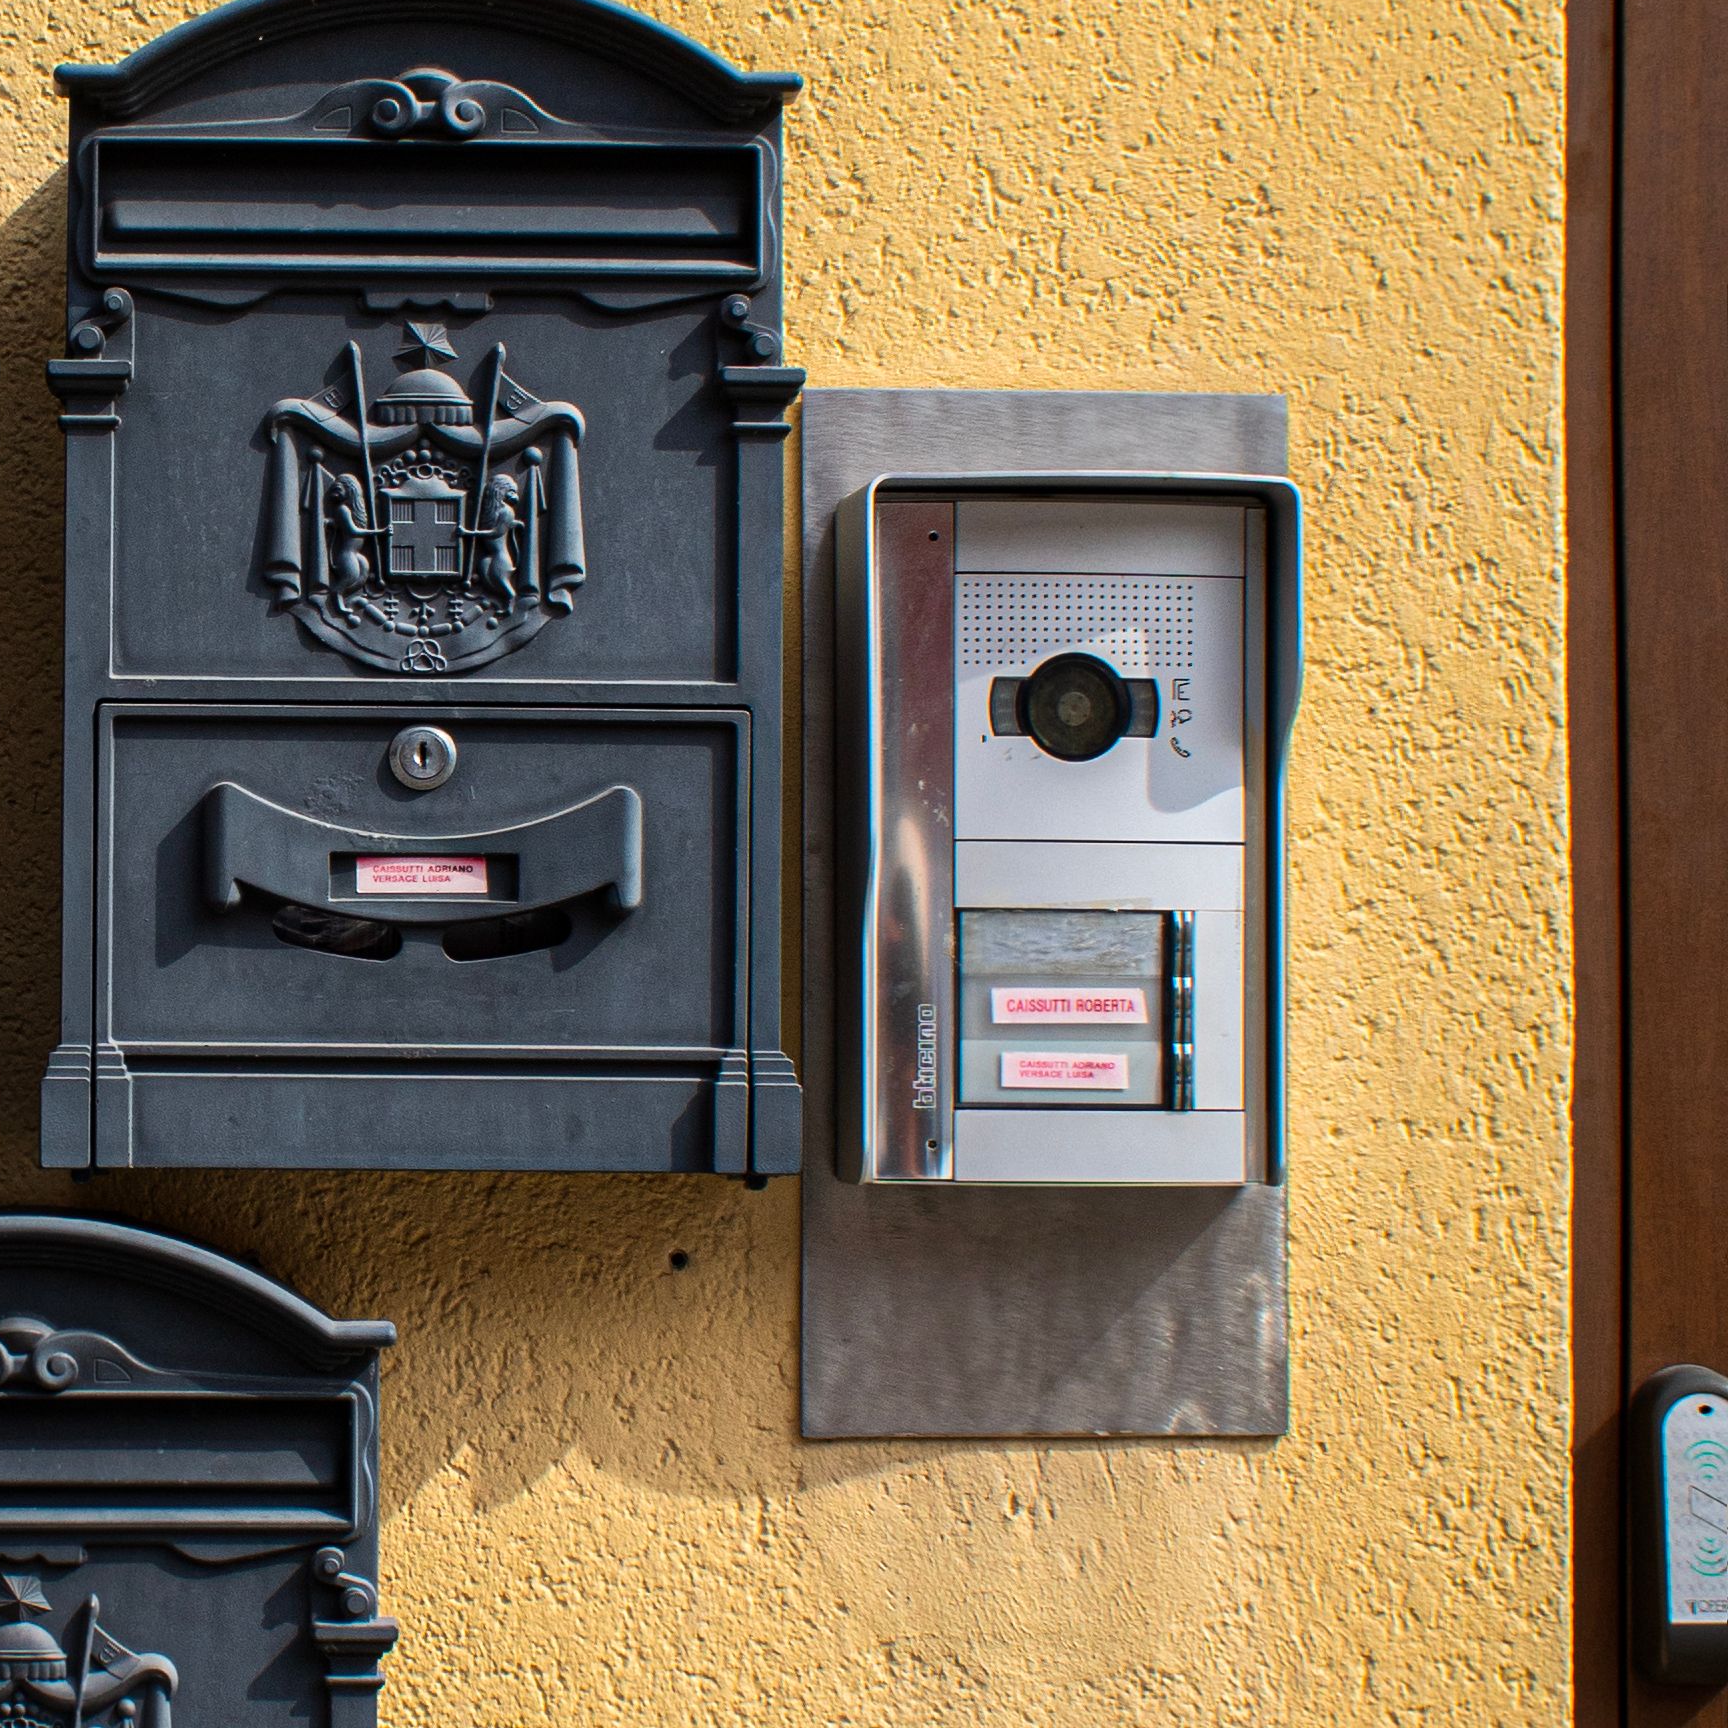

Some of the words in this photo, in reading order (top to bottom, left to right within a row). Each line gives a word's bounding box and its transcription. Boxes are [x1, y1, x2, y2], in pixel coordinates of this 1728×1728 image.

[1007, 999, 1071, 1012] CAISSUTTI
[1076, 999, 1135, 1012] ROBERTA
[912, 1003, 936, 1108] bticino
